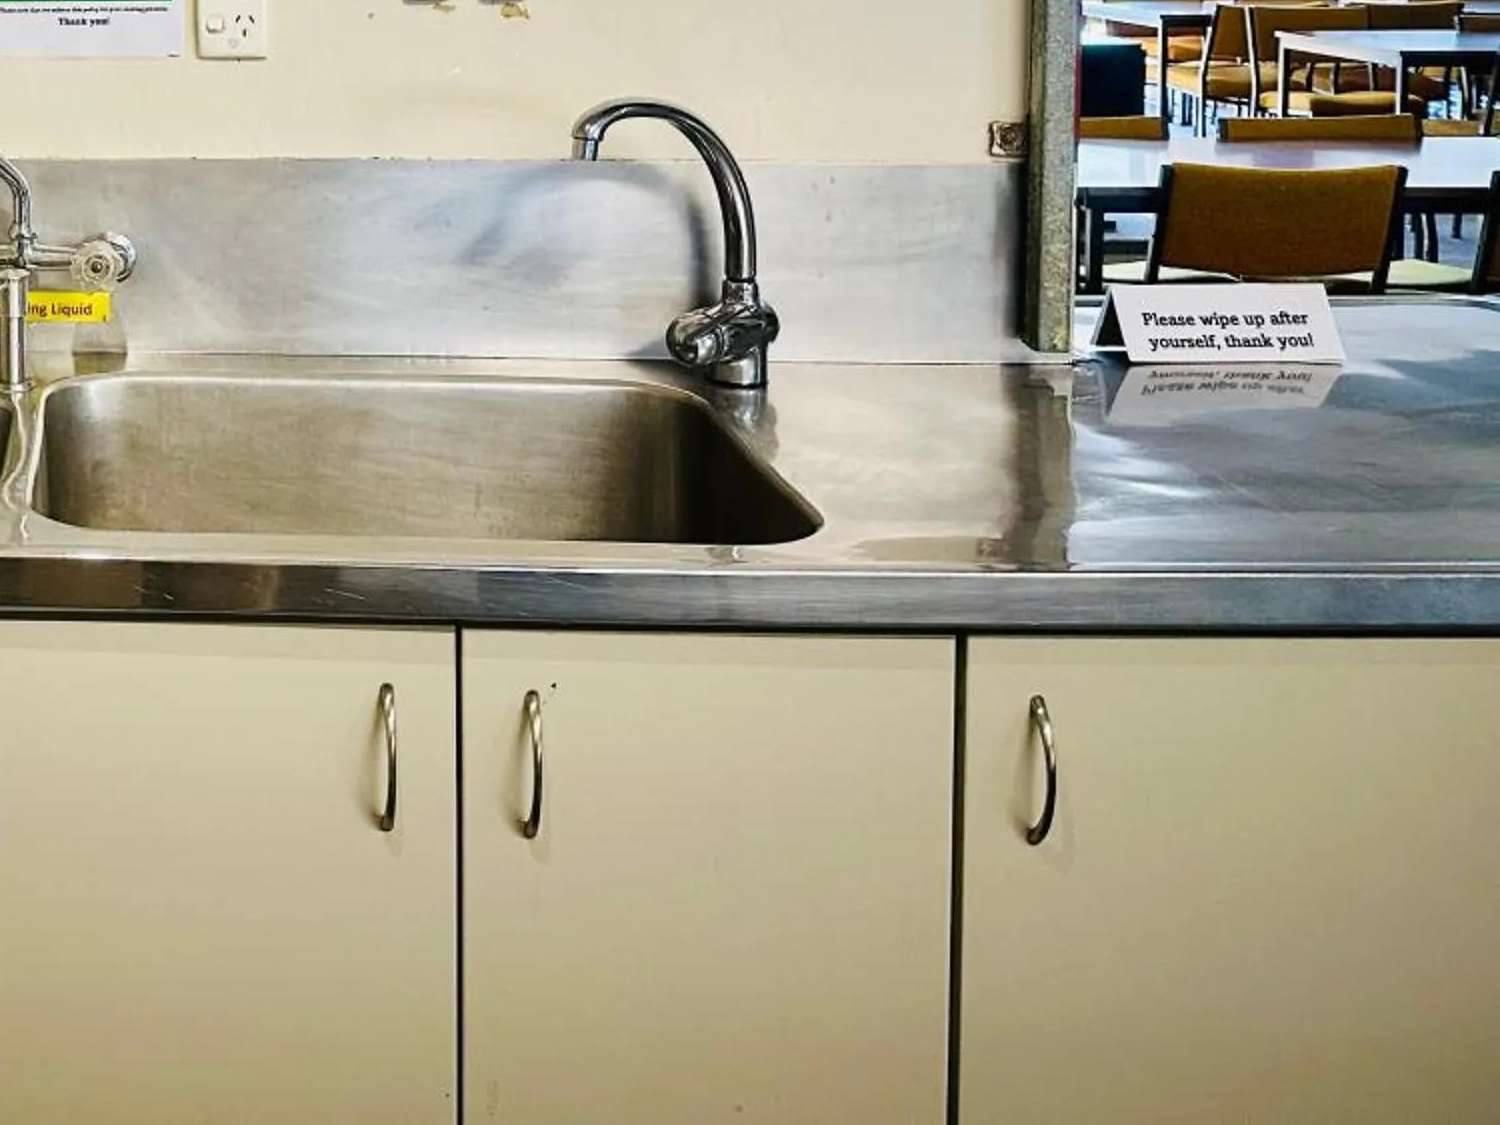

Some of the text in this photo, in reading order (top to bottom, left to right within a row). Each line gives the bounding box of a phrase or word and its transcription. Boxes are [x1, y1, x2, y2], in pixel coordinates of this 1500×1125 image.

[58, 17, 87, 26] Thank
[51, 302, 93, 317] Liquid
[1141, 311, 1308, 329] Please wipe up after
[1148, 333, 1314, 351] yourself, thank you!
